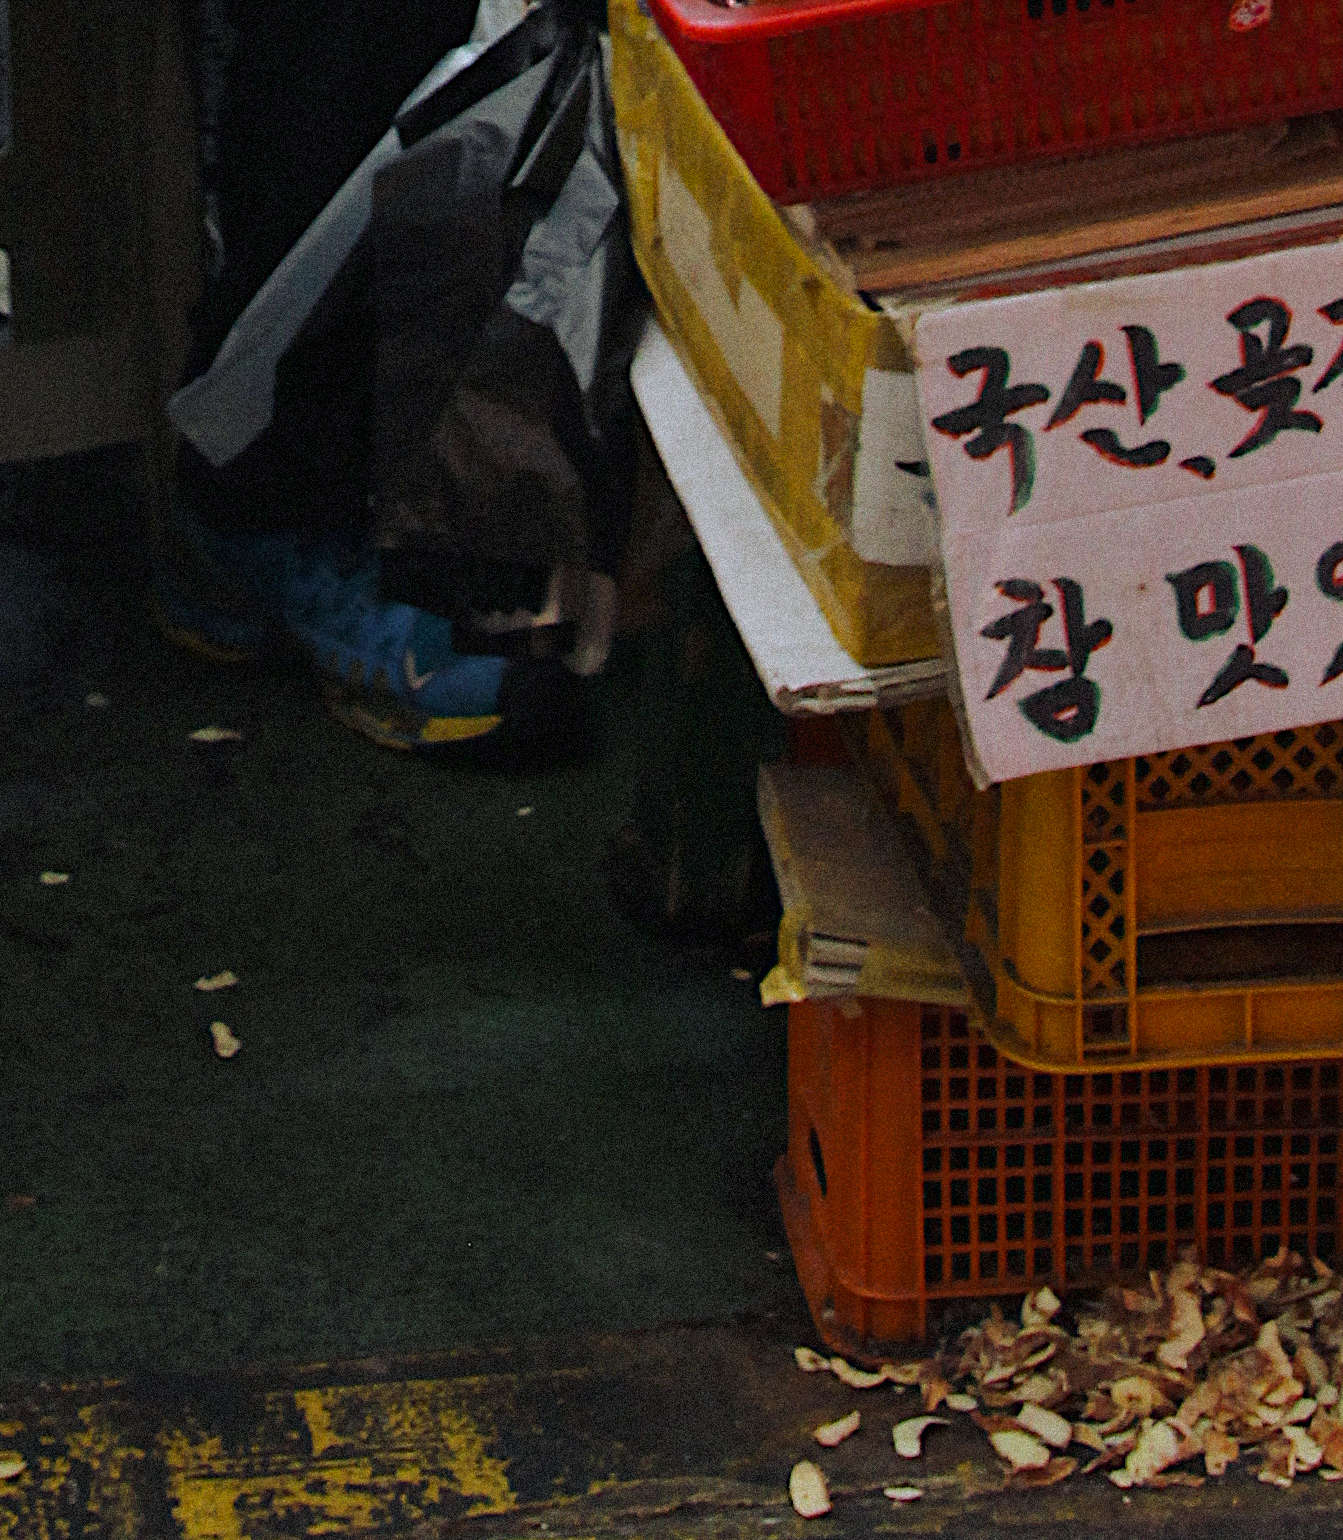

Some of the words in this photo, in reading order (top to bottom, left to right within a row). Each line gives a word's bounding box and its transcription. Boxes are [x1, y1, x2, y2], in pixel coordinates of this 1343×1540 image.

[1209, 295, 1343, 459] 곶
[979, 577, 1114, 743] 참
[1165, 542, 1343, 709] 맛
